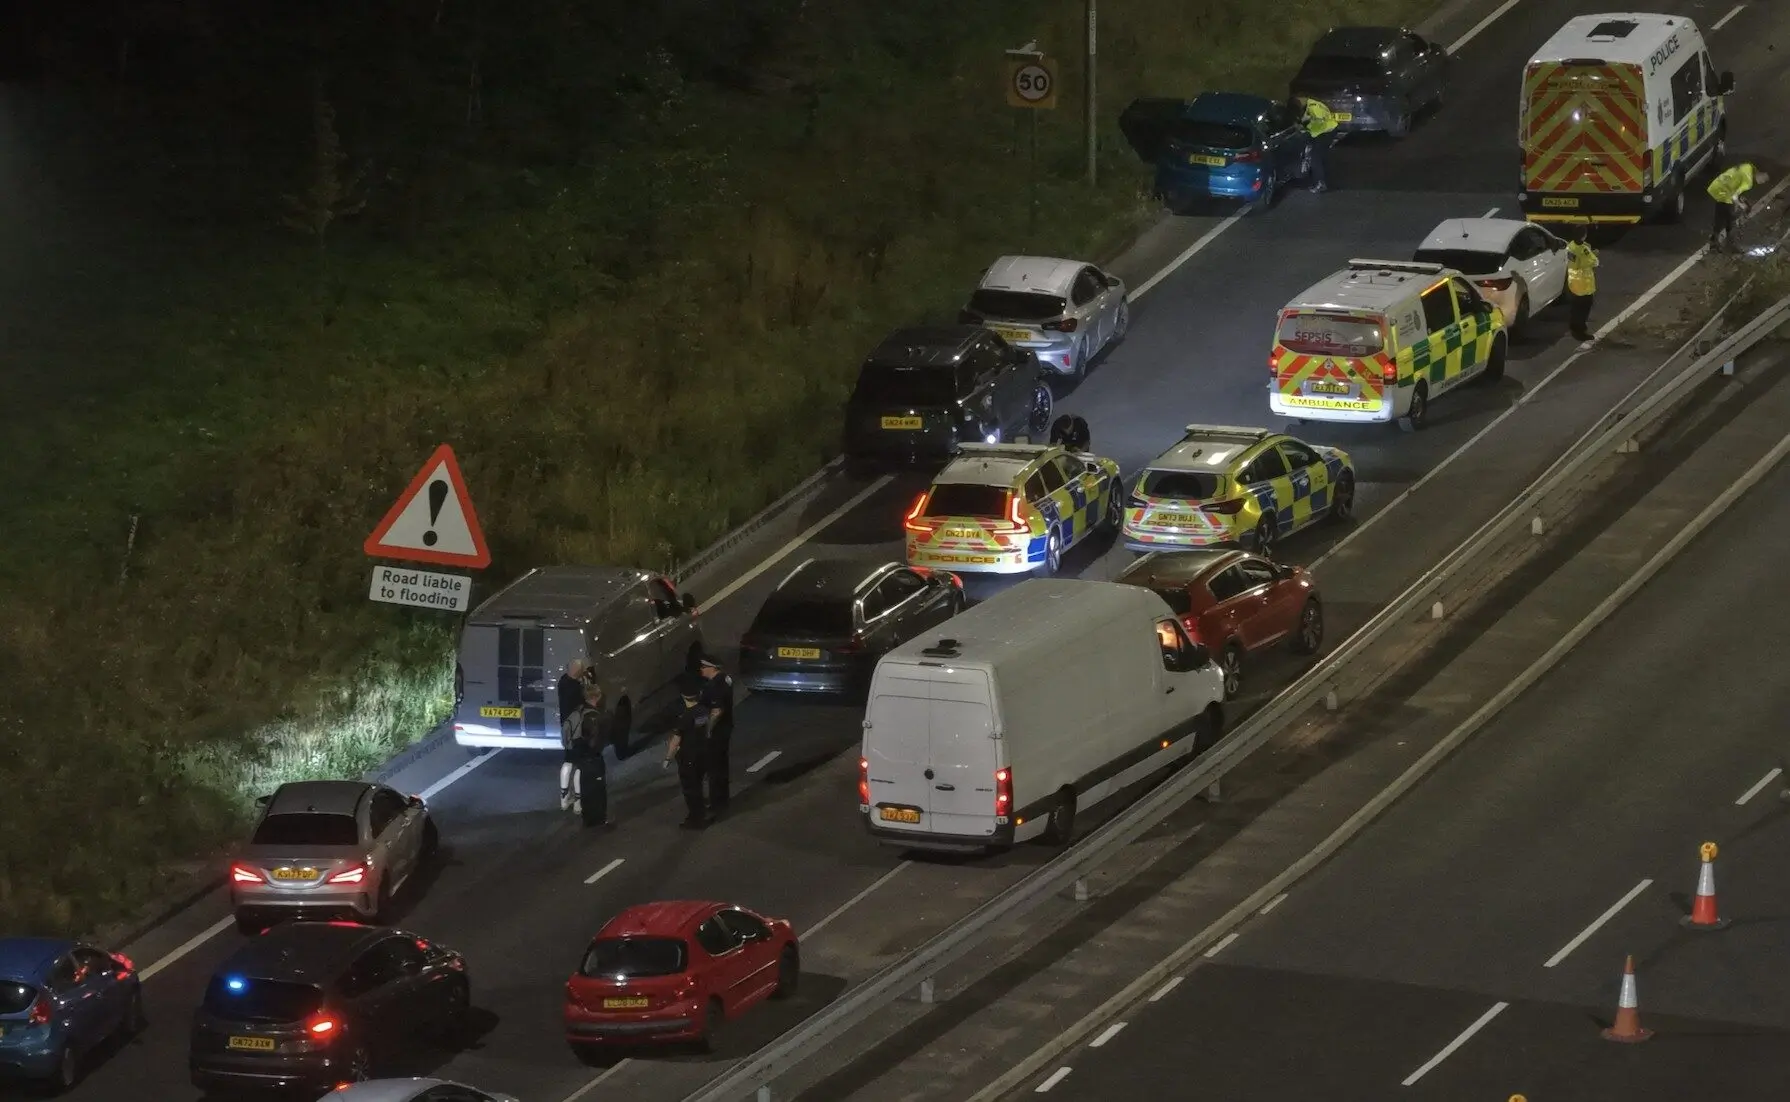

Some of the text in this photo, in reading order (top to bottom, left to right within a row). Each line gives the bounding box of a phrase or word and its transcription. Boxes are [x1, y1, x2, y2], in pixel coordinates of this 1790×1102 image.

[1650, 34, 1679, 71] POLICE
[1020, 75, 1047, 91] 50
[1294, 331, 1332, 343] SEPSIS
[1289, 398, 1370, 409] AMBULANCE
[1147, 520, 1203, 529] POLICE
[928, 555, 995, 564] POLICE
[382, 570, 462, 591] Road liable
[380, 586, 458, 608] to flooding
